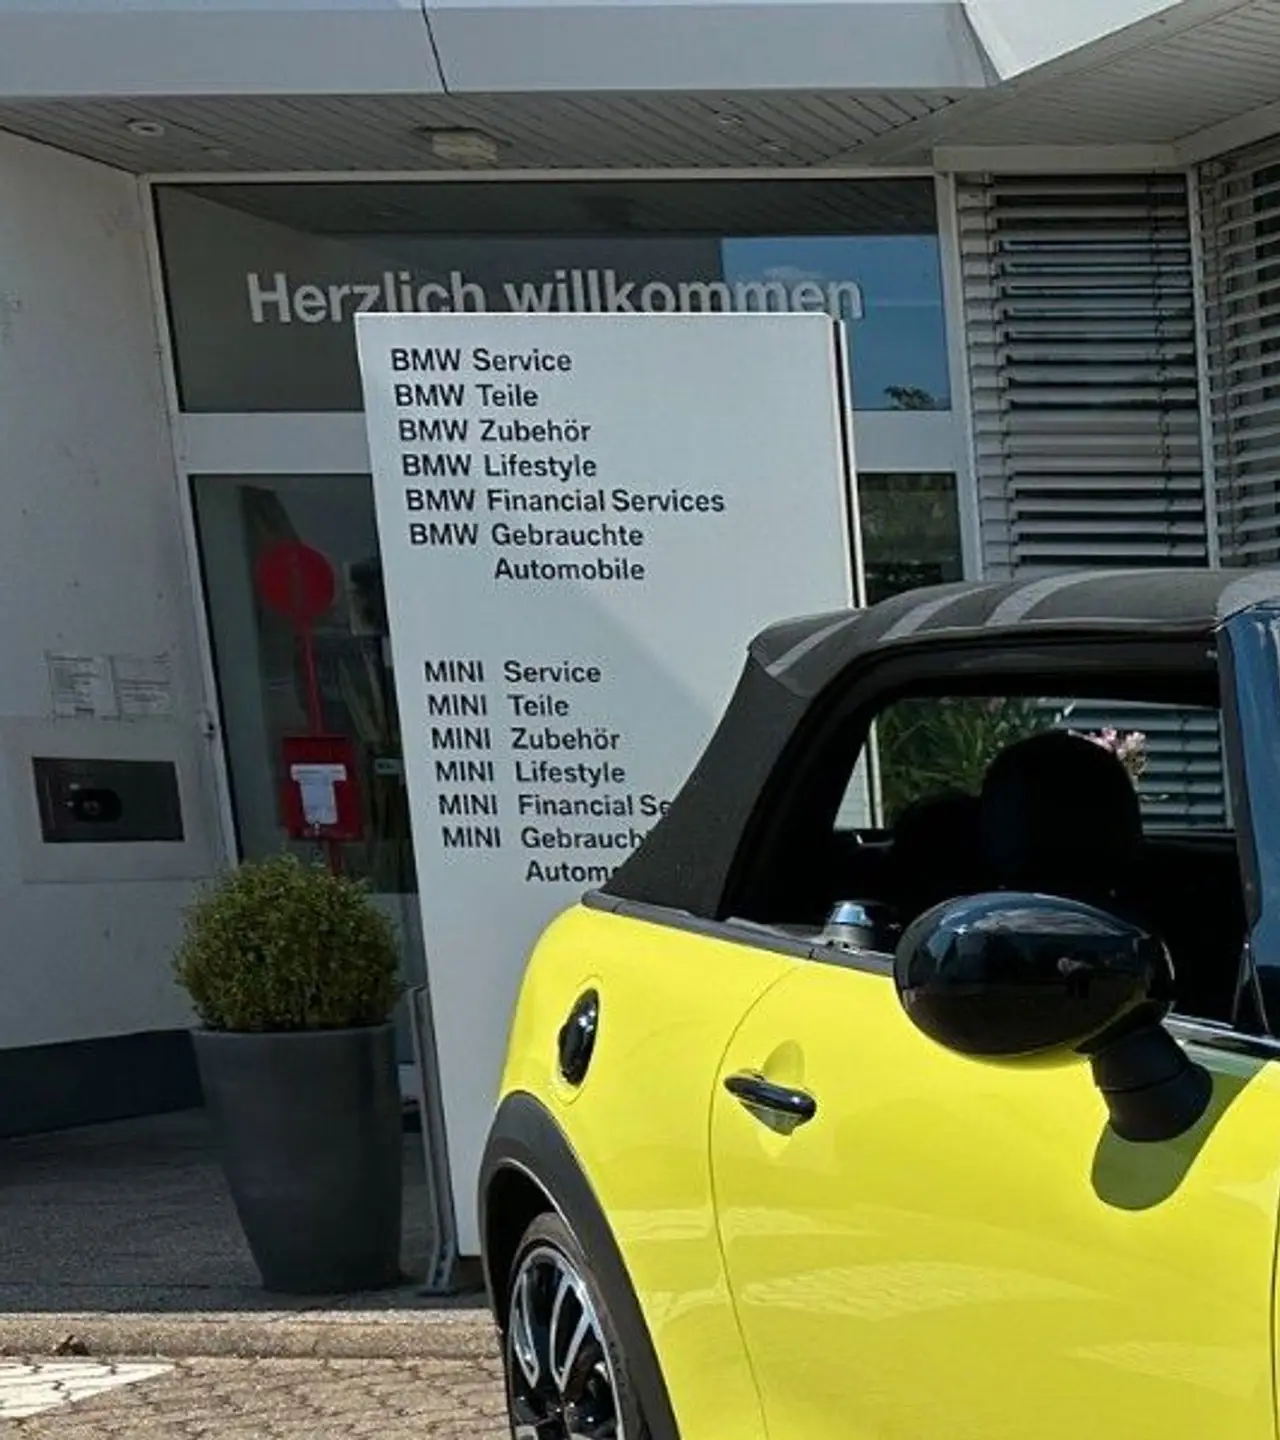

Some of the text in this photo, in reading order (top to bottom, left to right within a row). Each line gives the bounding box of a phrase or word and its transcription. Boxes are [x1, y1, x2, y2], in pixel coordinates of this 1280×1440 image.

[247, 269, 862, 323] Herzlich willkommen
[391, 347, 572, 372] BMW Service
[394, 383, 539, 407] BMW Teile
[398, 418, 591, 443] BMW Zubehör
[401, 453, 597, 483] BMW Lifestyle
[405, 488, 725, 513] BMW Financial Services
[409, 522, 644, 547] BMW Gebrauchte
[494, 557, 645, 581] Automobile
[424, 659, 601, 683] MINI Service
[427, 693, 570, 717] MINI Teile
[431, 727, 621, 750] MINI Zubehör
[434, 760, 626, 789] MINI Lifestyle
[438, 793, 498, 816] MINI
[518, 793, 634, 817] Financial
[441, 825, 647, 850] MINI Gebrauch
